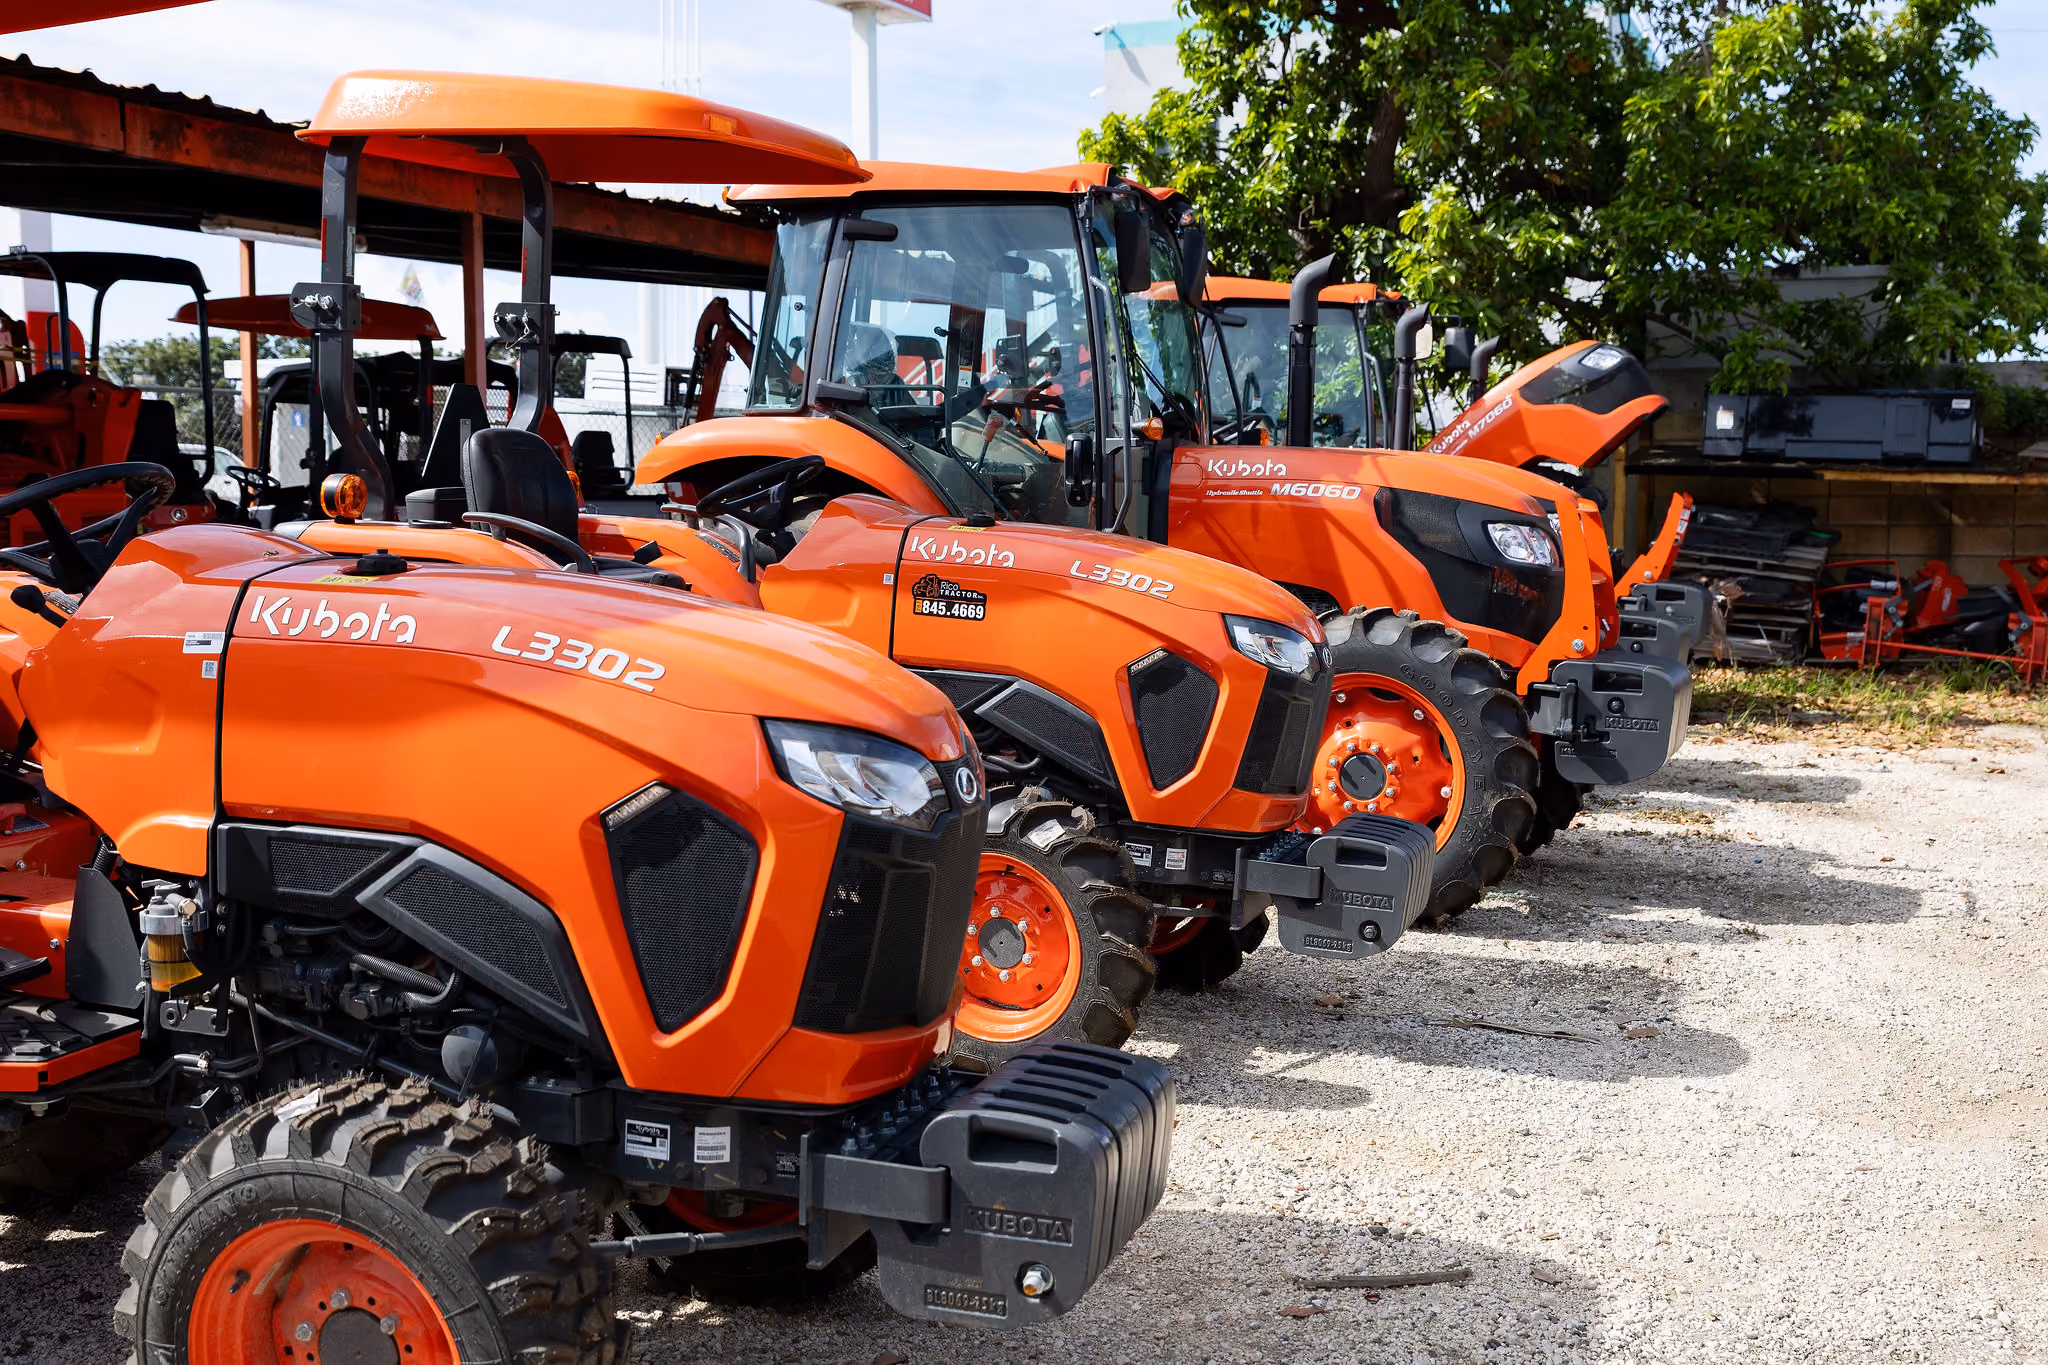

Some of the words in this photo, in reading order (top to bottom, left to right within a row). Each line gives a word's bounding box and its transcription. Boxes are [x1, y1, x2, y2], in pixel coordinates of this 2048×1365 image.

[1468, 397, 1513, 439] M7060
[1429, 420, 1471, 453] Kubota
[1207, 459, 1287, 476] Kubota
[1270, 483, 1362, 499] M6060
[910, 536, 1015, 567] Kubota
[940, 581, 959, 591] Rico
[940, 589, 978, 599] TRACTOR
[1069, 560, 1175, 599] L3302
[249, 595, 417, 644] Kubota
[922, 600, 984, 619] 845.4669
[490, 625, 667, 693] L3302
[1606, 718, 1659, 731] KUBOTA
[968, 1208, 1069, 1242] KUBOTA
